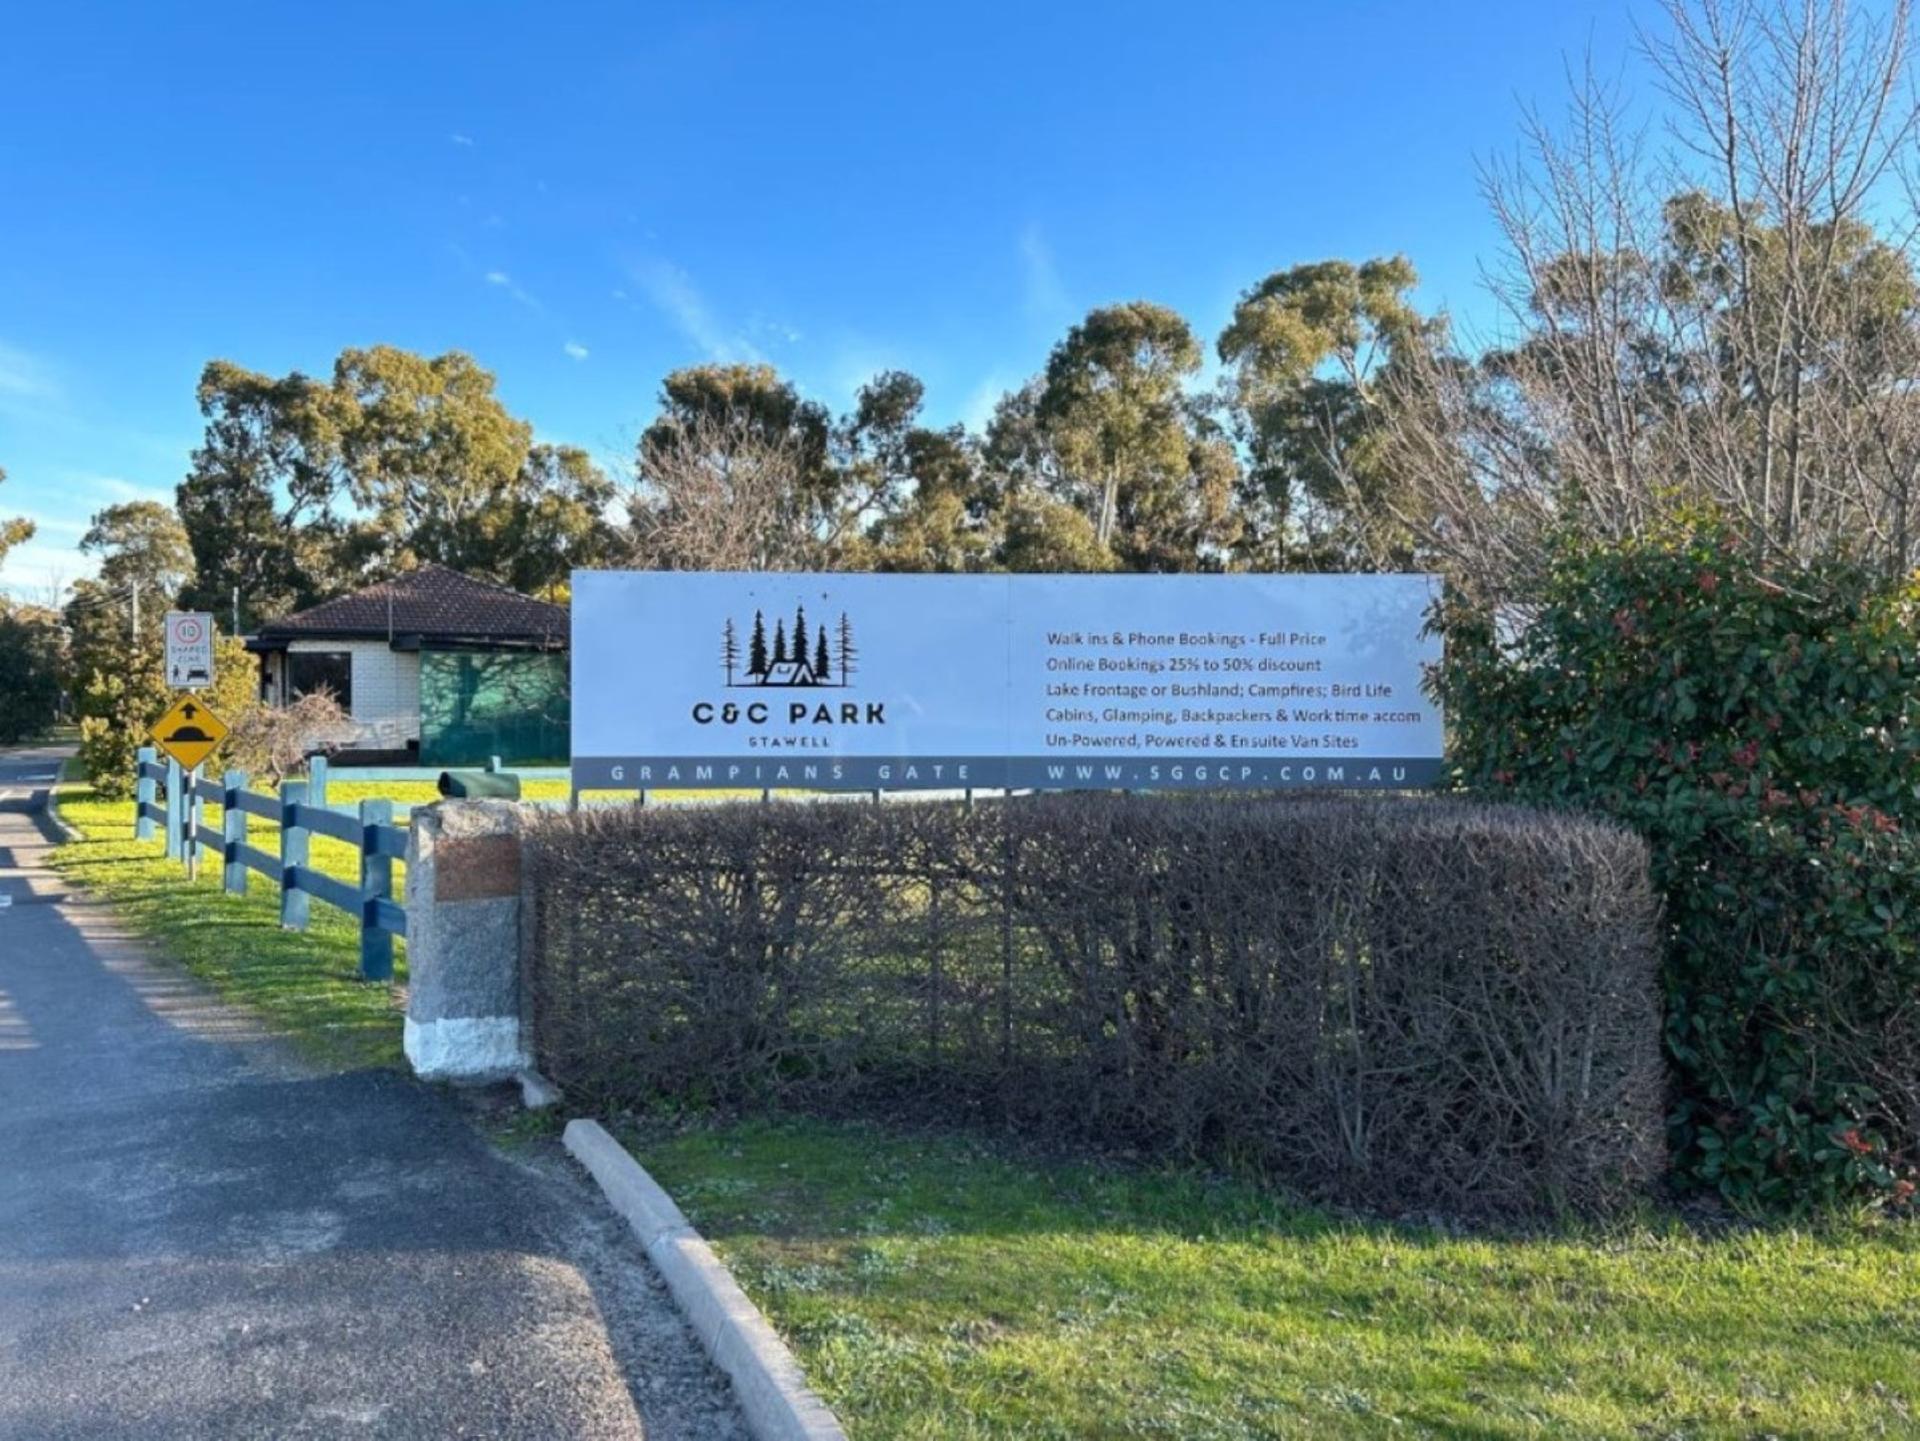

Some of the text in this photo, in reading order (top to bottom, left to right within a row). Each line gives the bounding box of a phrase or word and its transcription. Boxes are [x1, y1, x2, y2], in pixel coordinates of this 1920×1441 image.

[1047, 633, 1083, 645] Walk
[1088, 633, 1107, 645] ins
[1112, 633, 1124, 645] &
[1129, 633, 1174, 645] Phone
[1179, 633, 1245, 649] Bookings
[1259, 633, 1286, 645] Full
[1290, 633, 1326, 645] Price
[1047, 658, 1321, 673] Online Bookings 25% to 50% discount
[1047, 683, 1392, 700] Lake Frontage or Bushland; Campfires; Bird Life
[693, 703, 885, 724] C&C PARK
[1046, 709, 1098, 724] Cabins,
[1103, 709, 1177, 725] Glamping,
[1181, 709, 1272, 725] Backpackers
[1276, 709, 1288, 722] &
[1373, 712, 1421, 722] accom
[749, 737, 830, 748] STAWELL
[1145, 735, 1209, 748] Powered
[1214, 735, 1227, 748] &
[1291, 735, 1319, 748] Van
[1323, 735, 1358, 748] Sites
[611, 765, 968, 780] GRAMPIANS GATE
